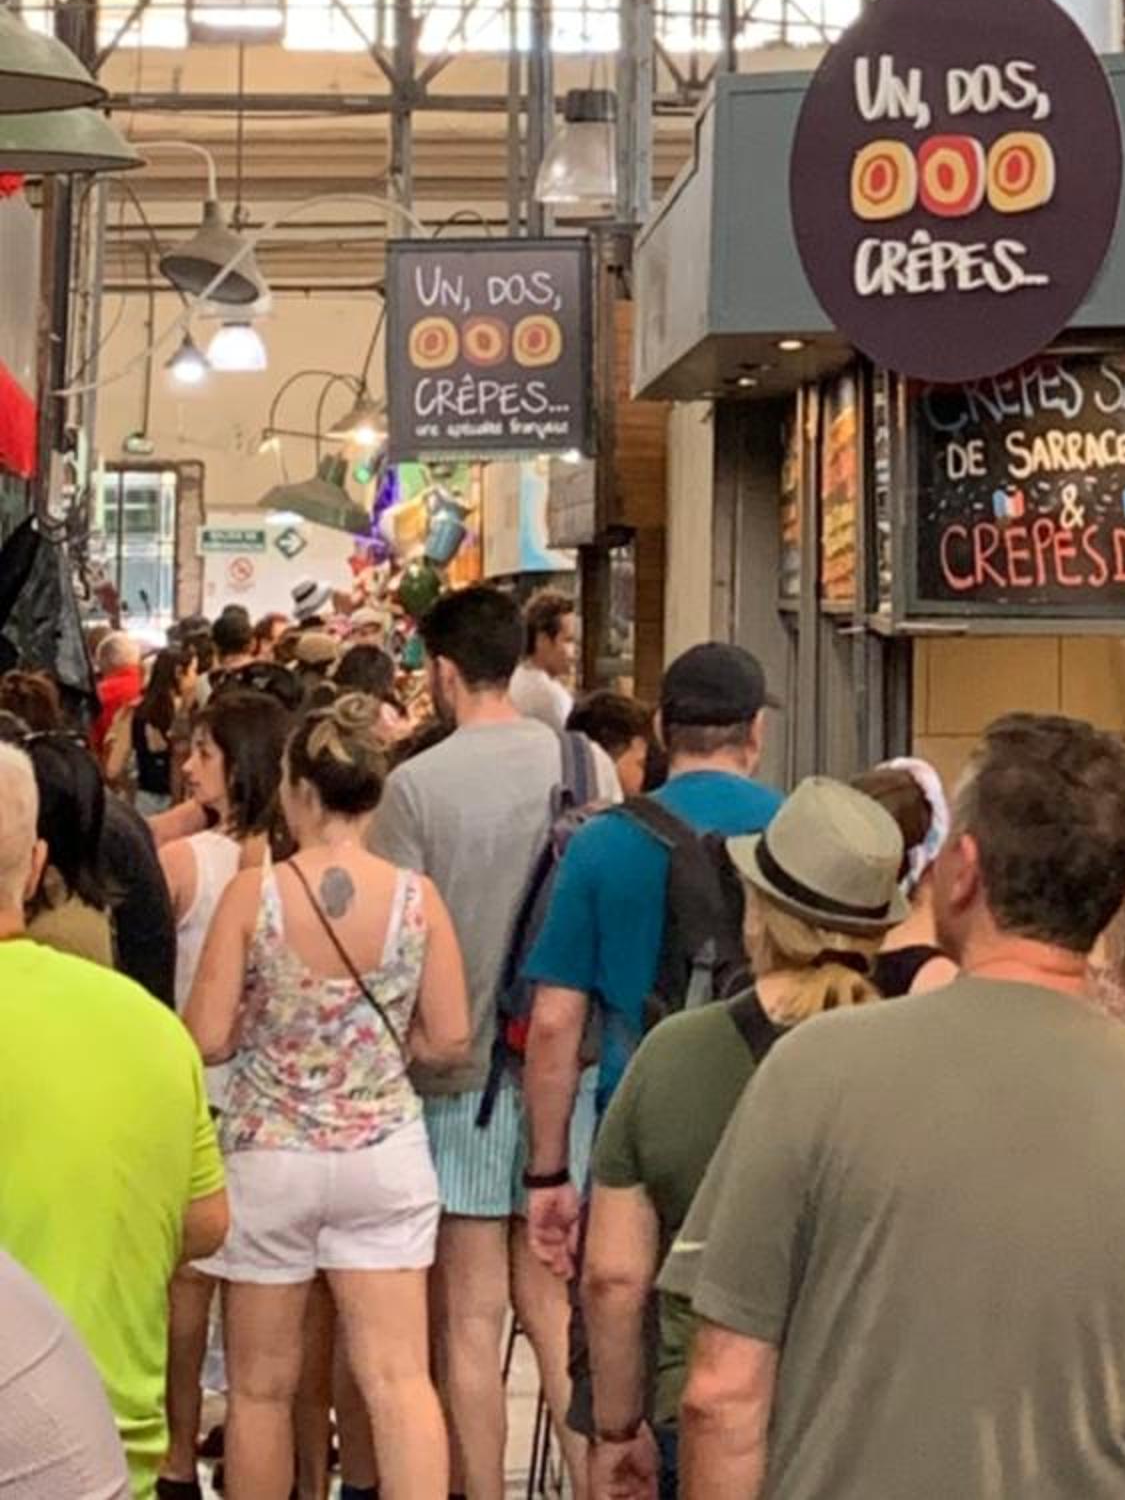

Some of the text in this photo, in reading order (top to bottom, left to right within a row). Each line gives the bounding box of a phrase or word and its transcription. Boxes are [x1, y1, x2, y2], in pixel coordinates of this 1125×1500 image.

[854, 55, 1050, 129] UN, DOS,
[487, 270, 562, 312] DOS,
[947, 438, 988, 480] DE
[939, 516, 1108, 590] CREPES
